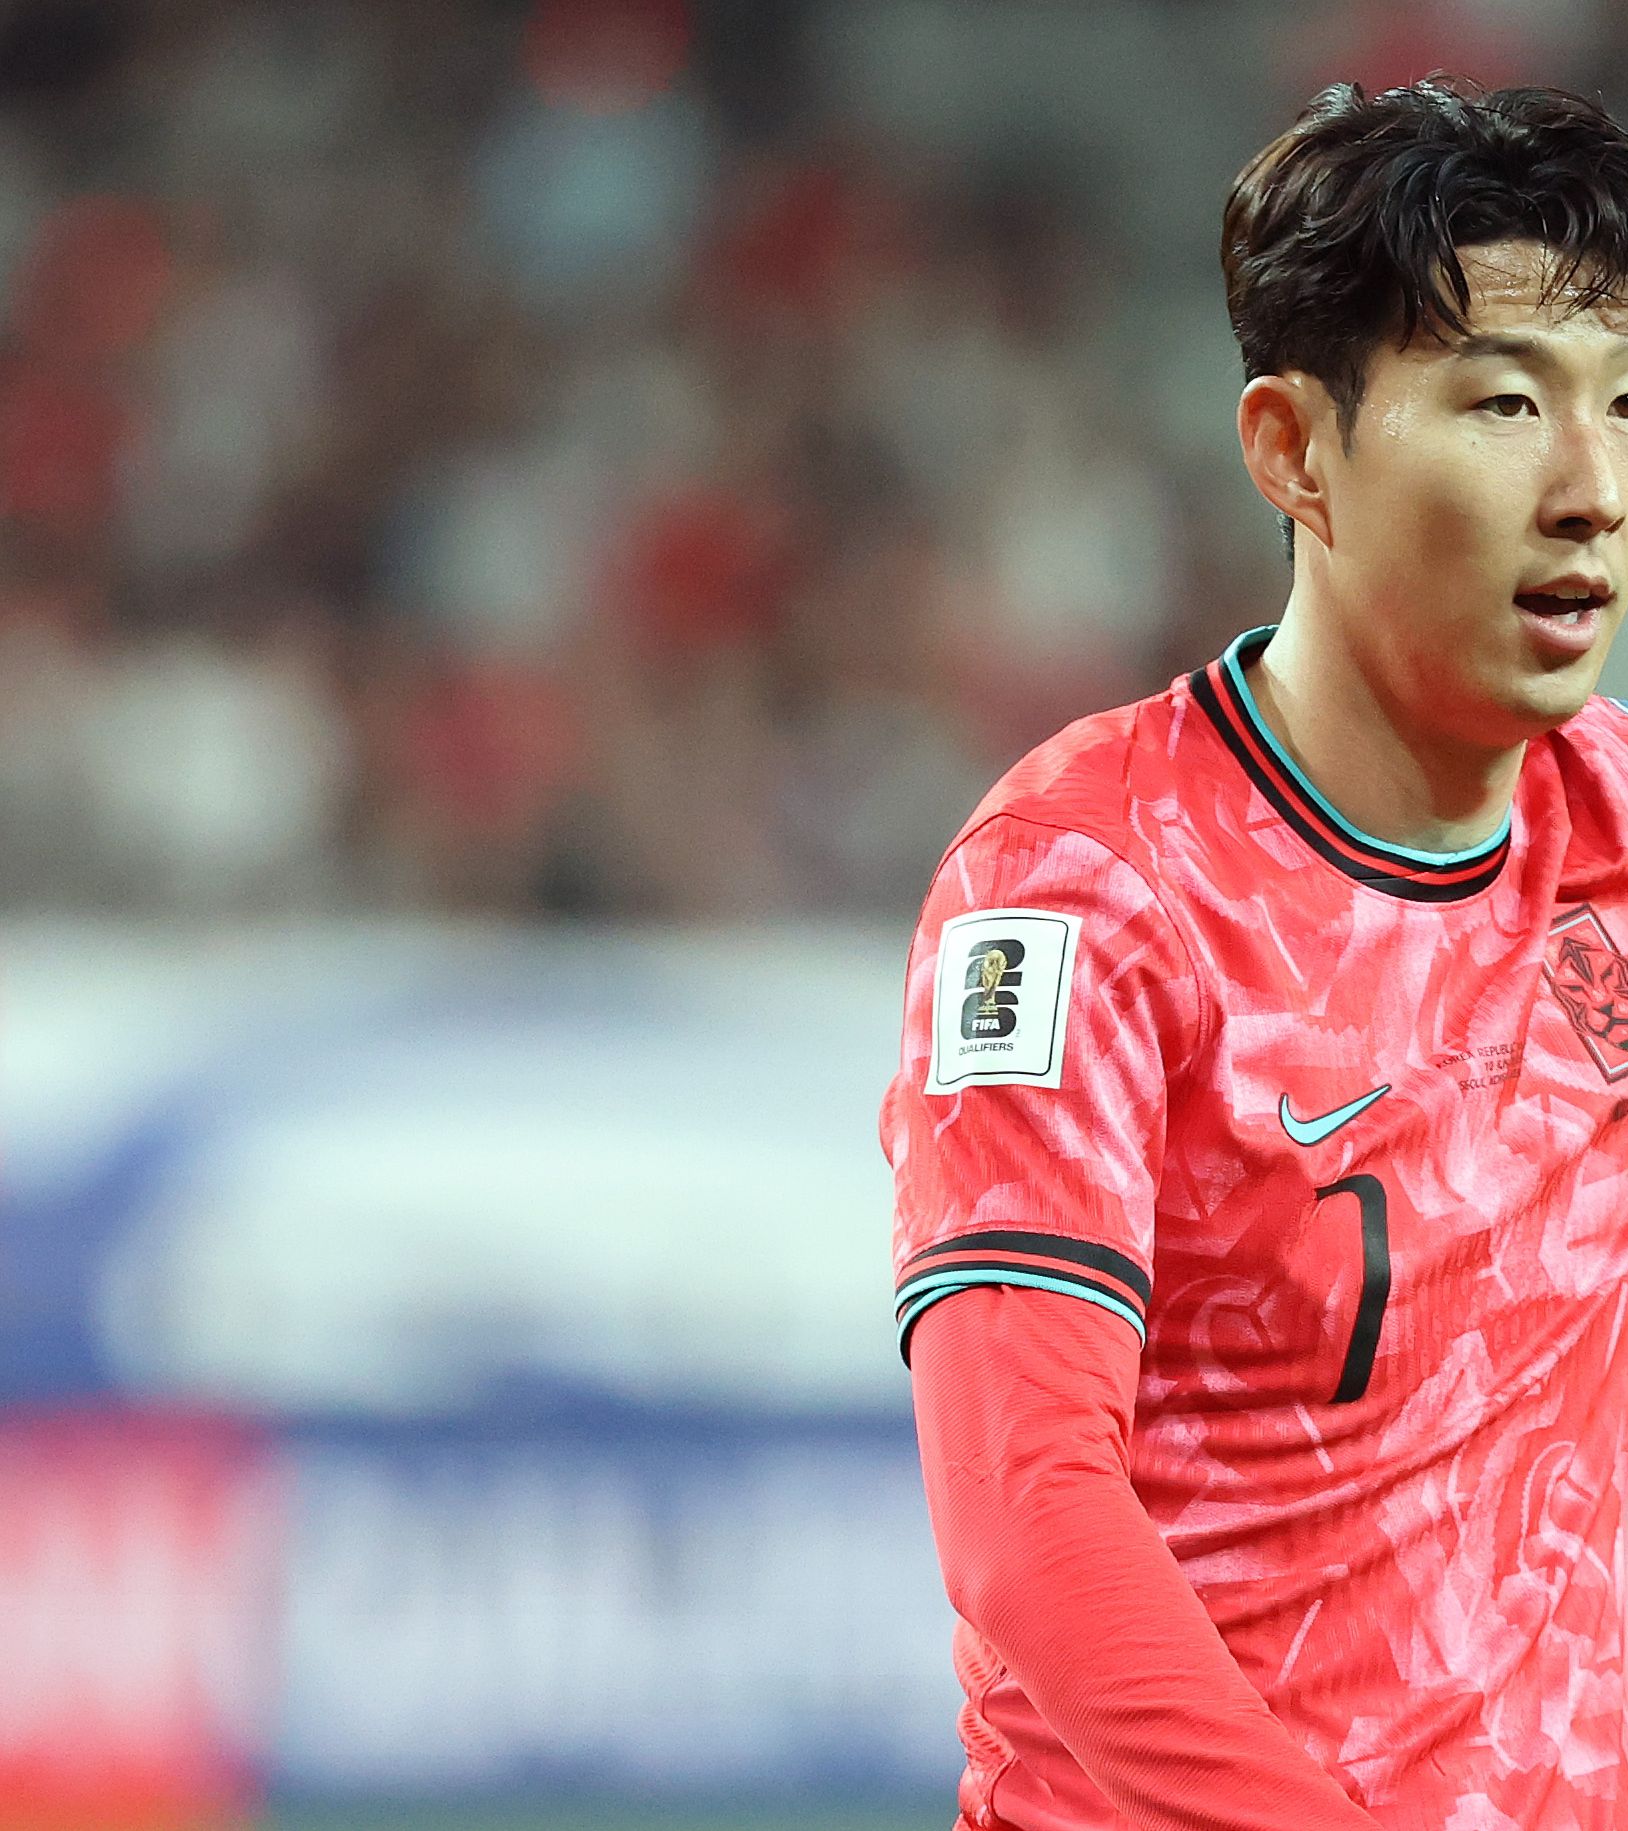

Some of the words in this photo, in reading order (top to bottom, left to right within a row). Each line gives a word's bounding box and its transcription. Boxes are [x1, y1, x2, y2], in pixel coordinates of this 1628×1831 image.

[971, 1018, 1000, 1032] FIFA
[958, 1042, 1014, 1056] QUALIFIERS
[1315, 1174, 1391, 1404] 7
